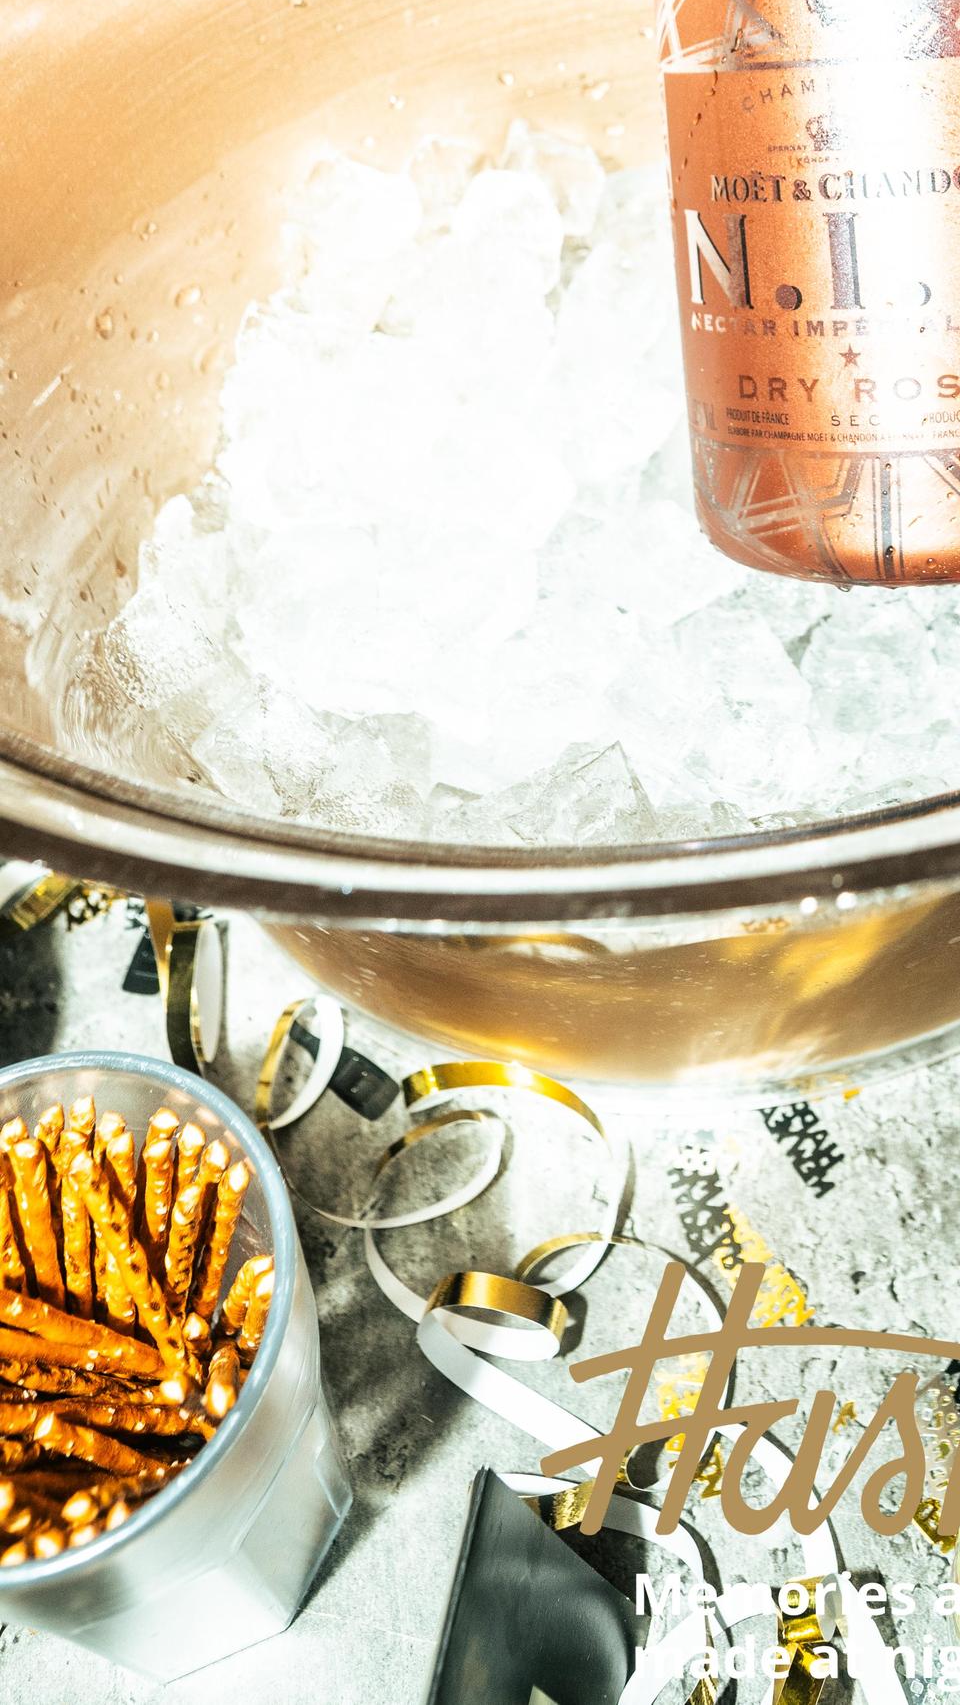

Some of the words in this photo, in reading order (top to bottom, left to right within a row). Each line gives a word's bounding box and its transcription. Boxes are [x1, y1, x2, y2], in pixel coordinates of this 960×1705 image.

[710, 170, 787, 202] MOËT
[792, 179, 813, 202] &
[738, 375, 820, 403] DRY
[762, 411, 790, 425] FRANCE
